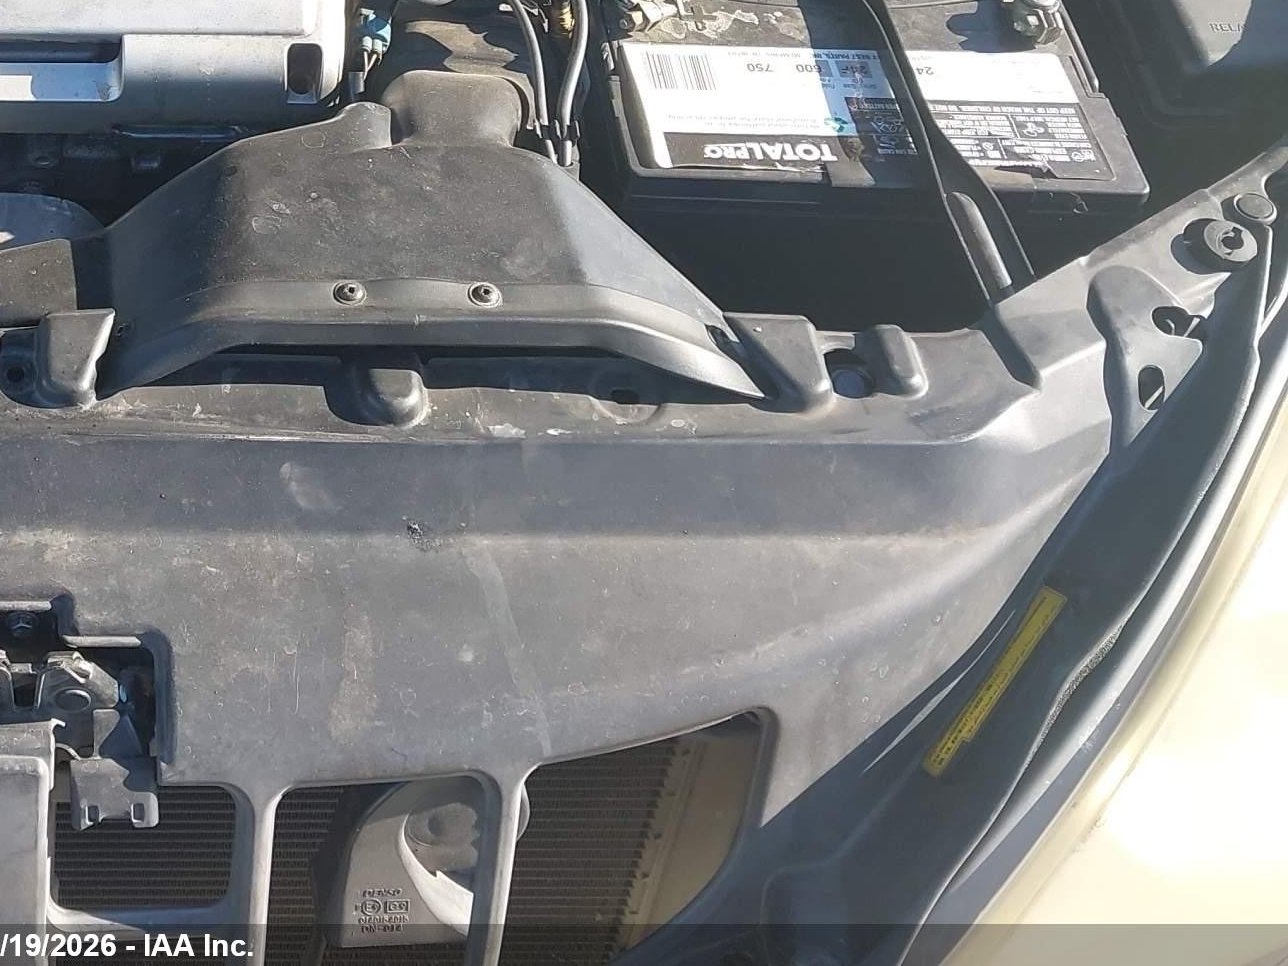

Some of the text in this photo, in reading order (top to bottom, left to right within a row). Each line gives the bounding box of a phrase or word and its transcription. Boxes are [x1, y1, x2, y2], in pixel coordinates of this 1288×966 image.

[746, 62, 773, 73] 750
[795, 63, 822, 74] 600
[703, 141, 839, 162] TOTALPRO
